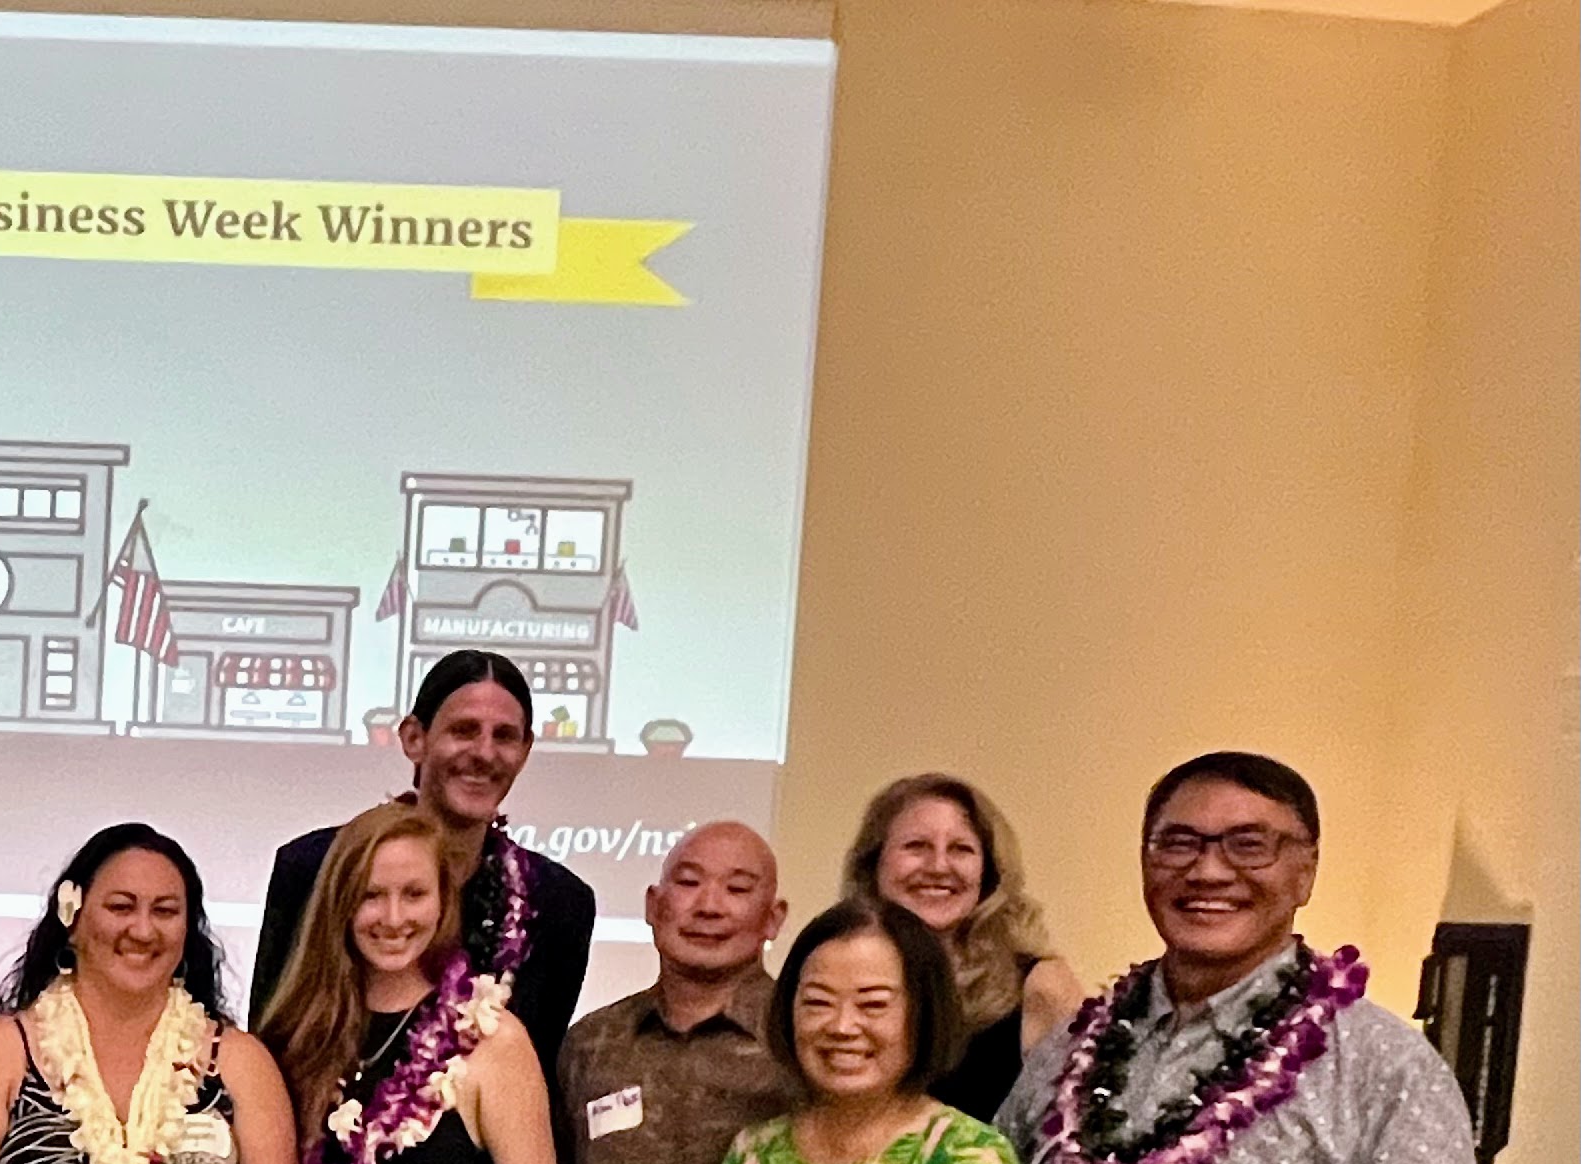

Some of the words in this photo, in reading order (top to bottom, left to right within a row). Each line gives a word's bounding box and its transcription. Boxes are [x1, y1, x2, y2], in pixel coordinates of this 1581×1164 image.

[162, 198, 302, 243] Week
[318, 203, 533, 250] Winners
[422, 616, 590, 640] MANUFACTURING
